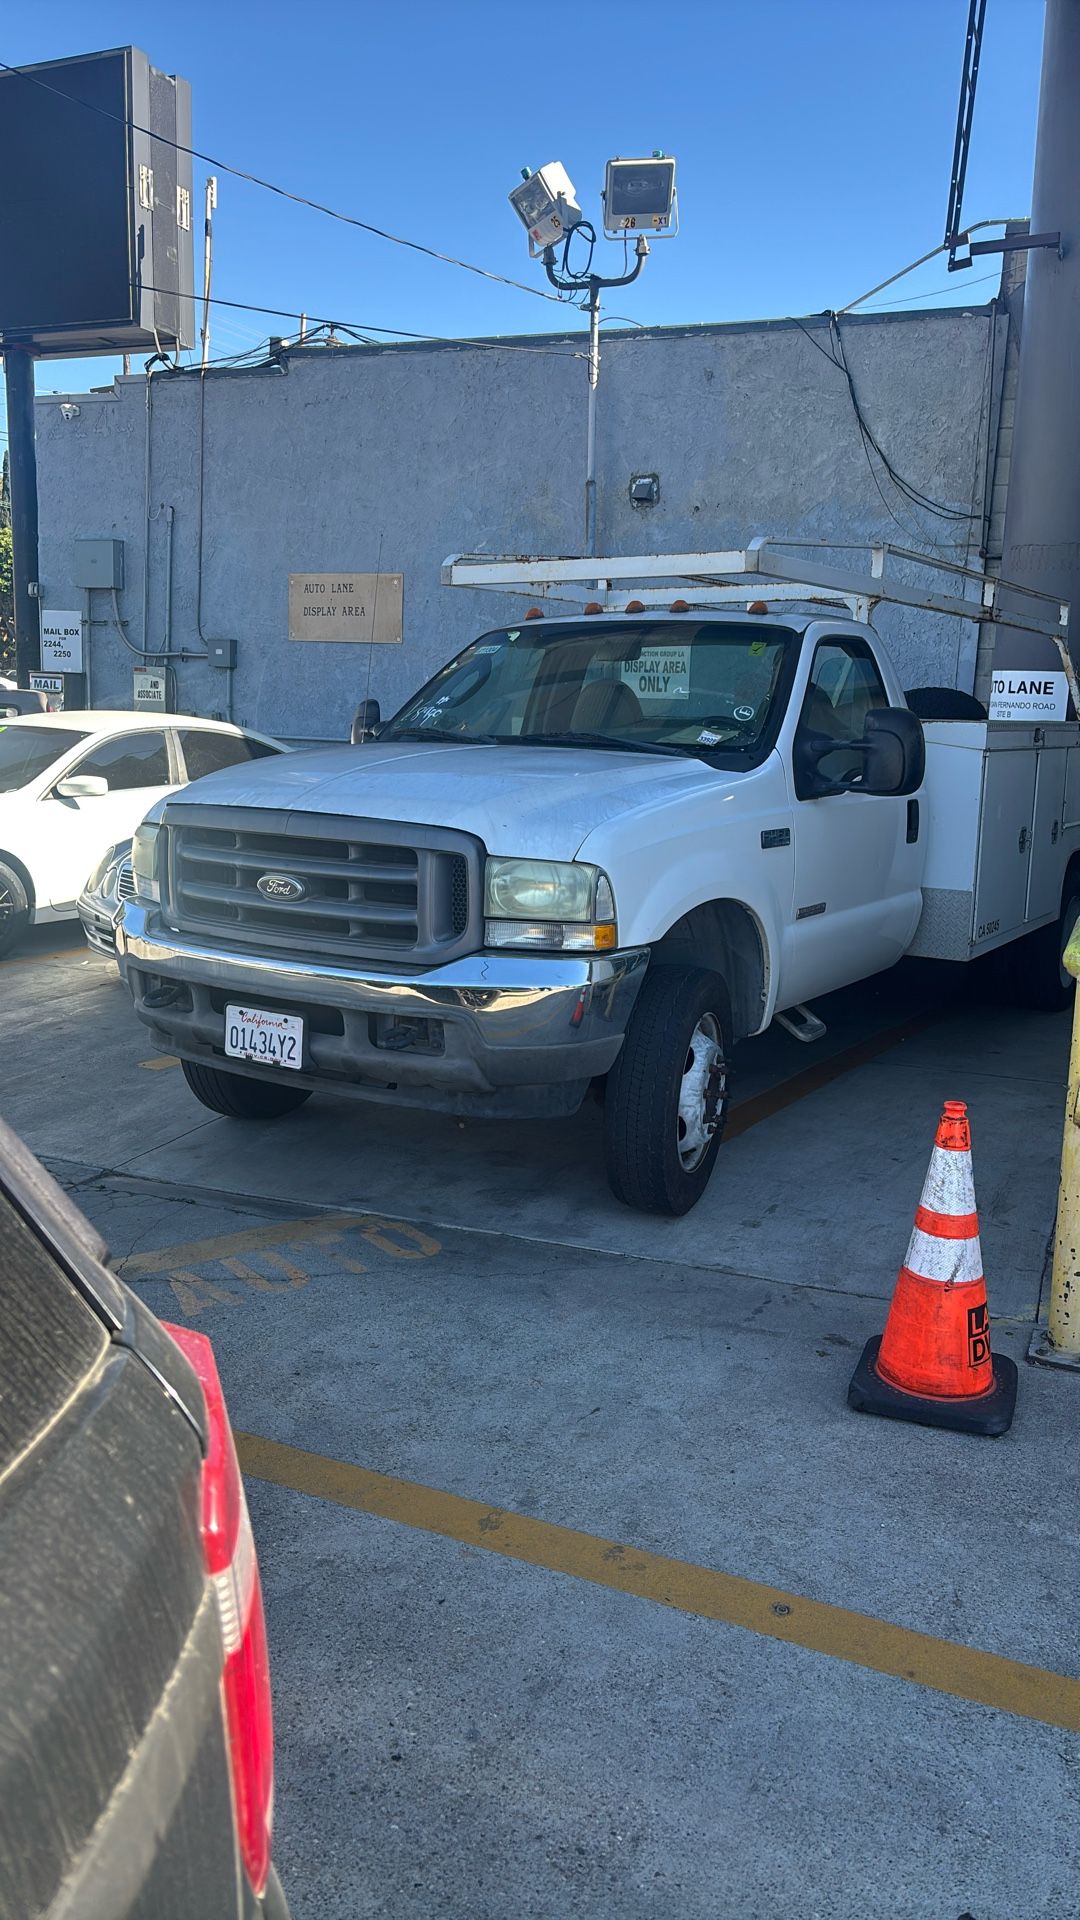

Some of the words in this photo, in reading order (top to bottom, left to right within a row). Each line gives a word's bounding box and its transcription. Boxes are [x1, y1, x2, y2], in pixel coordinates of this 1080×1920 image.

[304, 583, 325, 594] AUTO
[331, 583, 354, 594] LANE
[303, 606, 337, 617] DISPLAY
[342, 606, 366, 617] AREA
[43, 628, 62, 636] MAIL
[64, 628, 80, 636] BOX
[43, 640, 64, 649] 2244,
[53, 650, 72, 658] 2250
[624, 660, 661, 673] DISPLAY
[662, 660, 687, 674] AREA
[33, 679, 60, 690] MAIL
[150, 680, 159, 689] AND
[638, 675, 671, 693] ONLY
[1008, 680, 1055, 695] LANE
[137, 690, 162, 700] ASSOCIATE
[998, 701, 1031, 710] FERNANDO
[1032, 703, 1056, 711] ROAD
[996, 710, 1006, 718] STE
[266, 879, 291, 895] Ford
[978, 924, 986, 938] CA
[241, 1011, 288, 1030] California
[230, 1025, 297, 1061] 01434Y2
